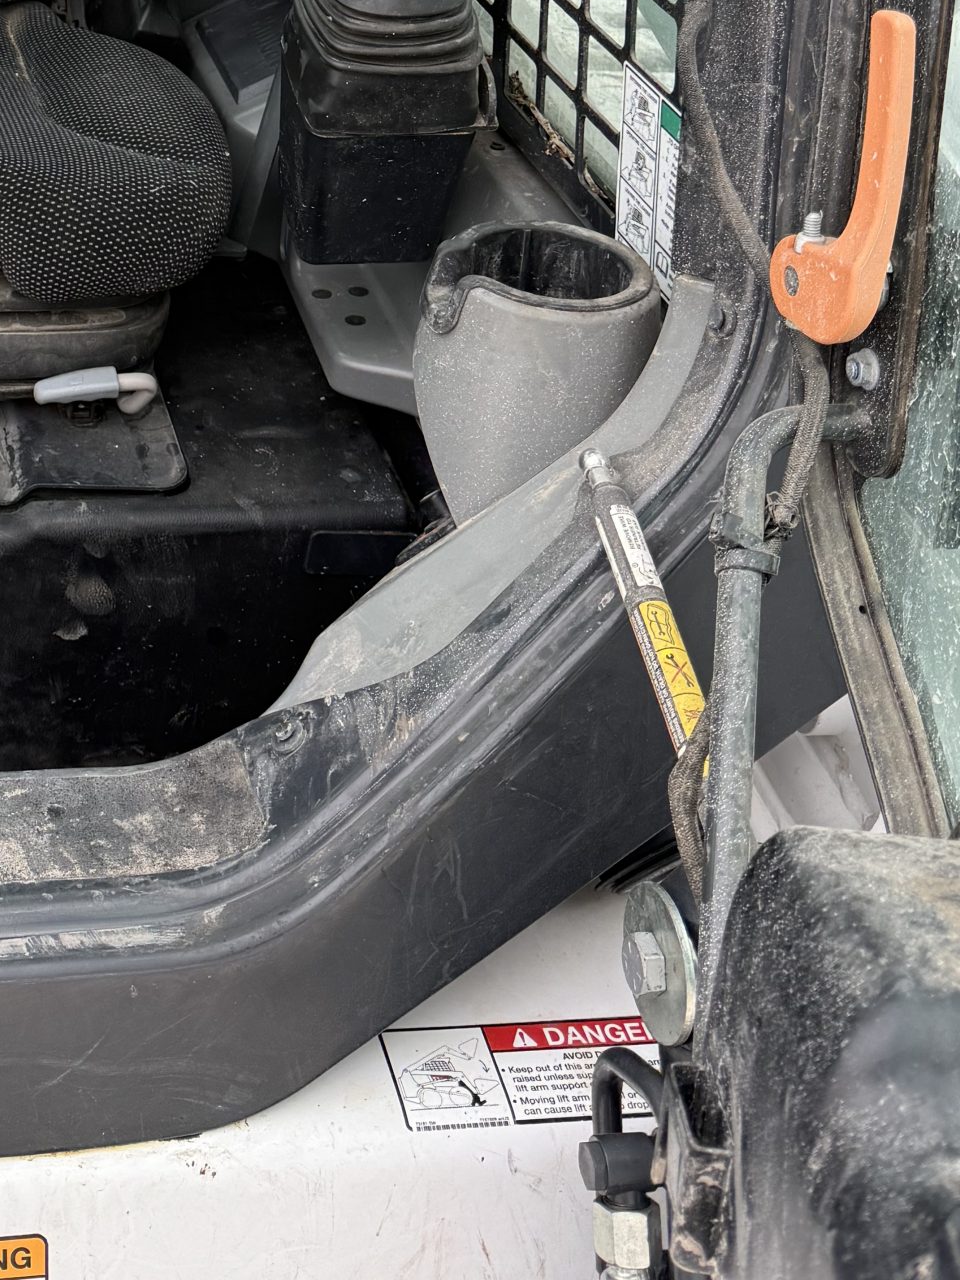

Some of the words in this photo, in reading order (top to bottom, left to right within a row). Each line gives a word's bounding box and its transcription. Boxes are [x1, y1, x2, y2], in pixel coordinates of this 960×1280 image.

[563, 1052, 593, 1060] AVOID
[513, 1074, 541, 1083] raised
[544, 1073, 574, 1082] unless
[516, 1084, 528, 1092] lift
[552, 1081, 588, 1091] support
[519, 1095, 555, 1105] Moving
[557, 1094, 570, 1102] lift
[545, 1105, 572, 1114] cause
[574, 1104, 587, 1112] lift
[627, 1101, 650, 1109] drop
